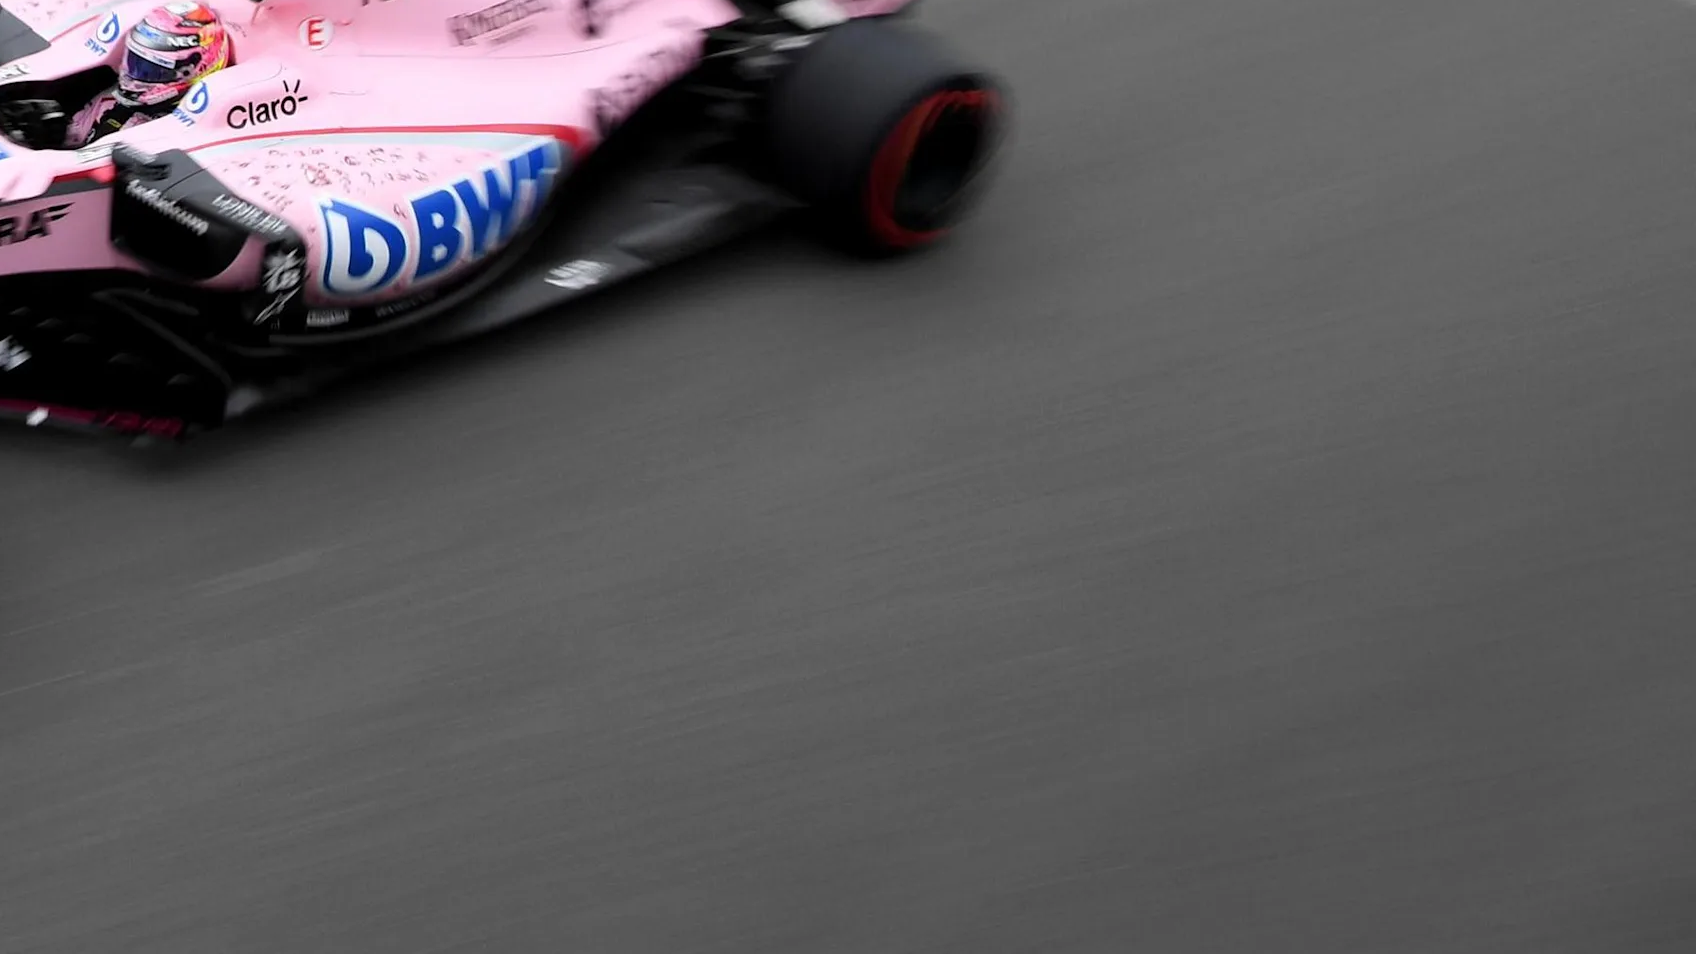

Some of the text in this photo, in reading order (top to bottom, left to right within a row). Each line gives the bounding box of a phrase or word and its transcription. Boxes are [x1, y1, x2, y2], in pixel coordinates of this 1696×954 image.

[167, 34, 200, 48] NEC
[307, 19, 325, 46] E
[226, 94, 298, 130] Claro
[411, 144, 560, 280] BWT
